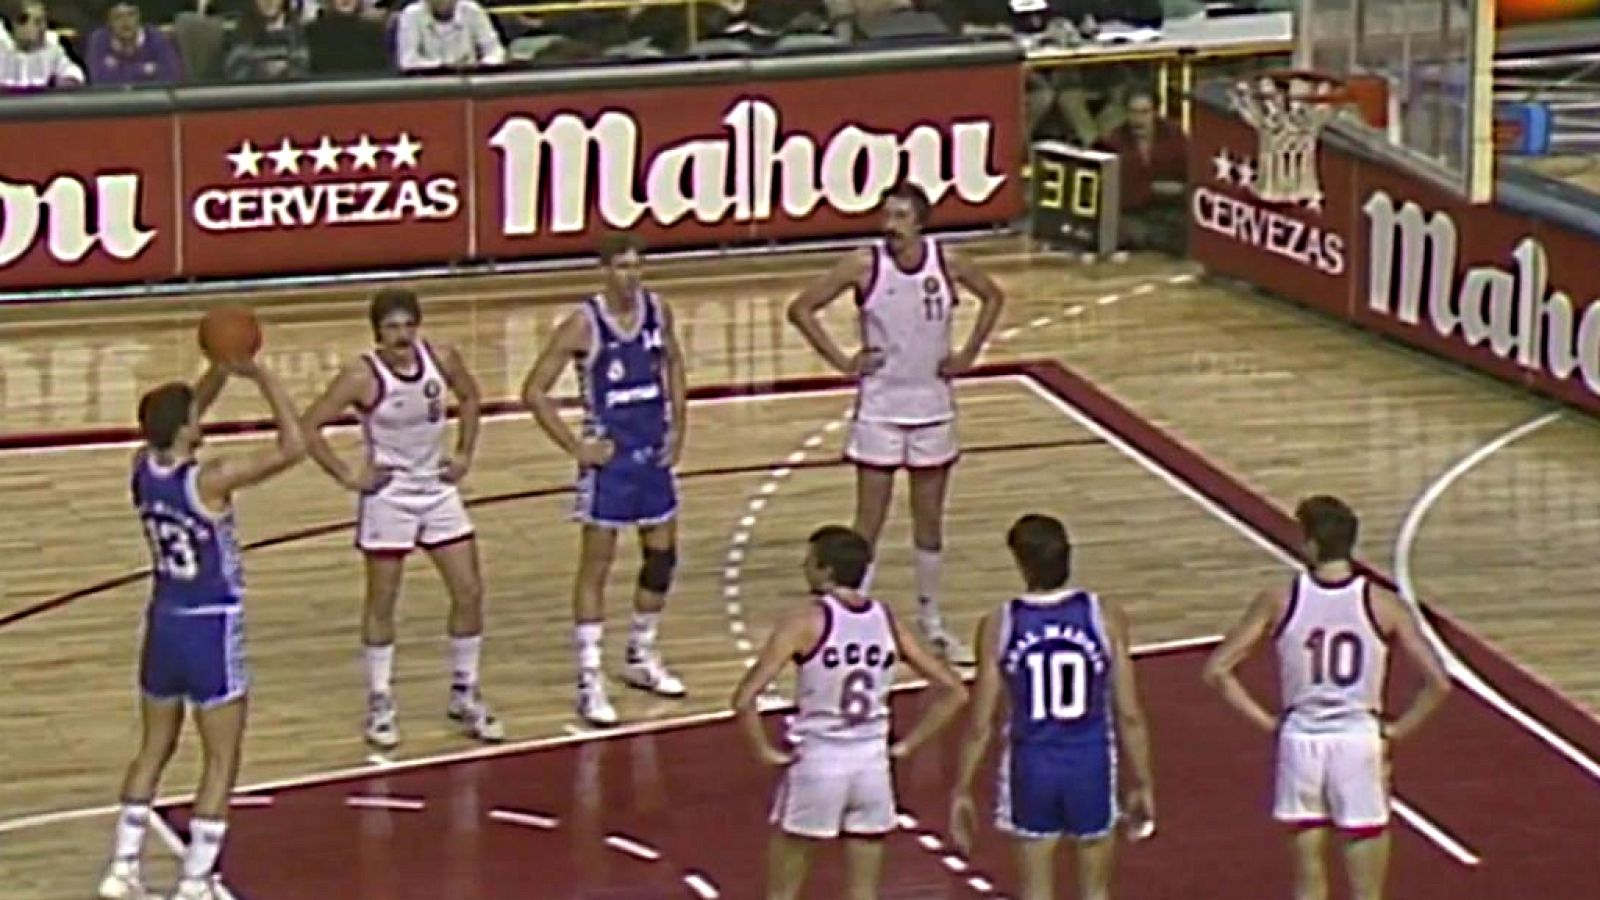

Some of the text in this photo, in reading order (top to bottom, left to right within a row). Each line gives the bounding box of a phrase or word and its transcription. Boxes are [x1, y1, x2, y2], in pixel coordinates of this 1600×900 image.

[489, 99, 1007, 236] Mahou
[1038, 160, 1098, 217] 30
[192, 177, 459, 231] CERVEZAS
[1193, 187, 1345, 276] CERVEZAS
[923, 296, 944, 322] 11
[146, 517, 199, 580] 13
[1026, 650, 1087, 720] 10
[1302, 626, 1364, 689] 10
[840, 668, 875, 728] 6
